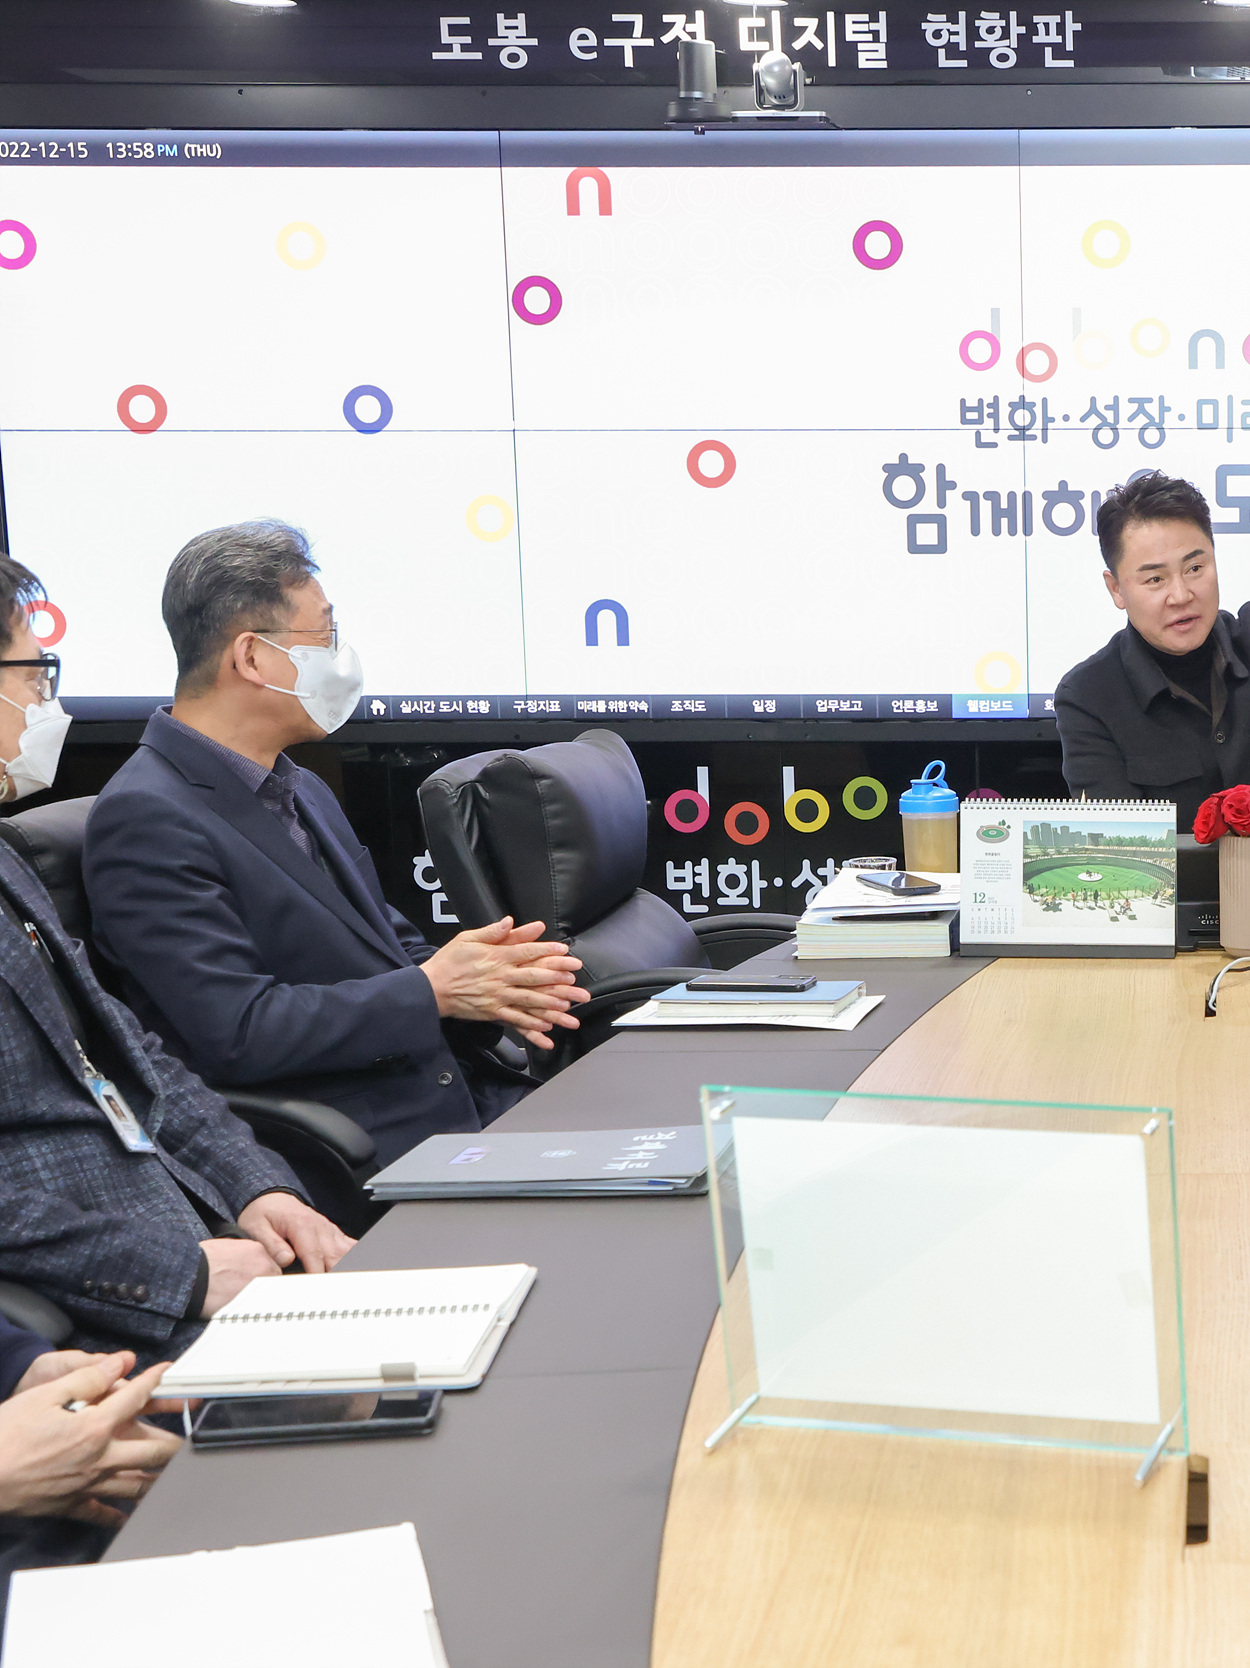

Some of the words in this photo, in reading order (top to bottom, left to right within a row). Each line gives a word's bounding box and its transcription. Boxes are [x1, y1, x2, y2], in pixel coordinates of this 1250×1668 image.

[432, 12, 539, 70] 도봉
[738, 10, 889, 69] 디지털
[920, 10, 1083, 69] 현황판
[0, 141, 89, 159] 022-12-15
[105, 142, 155, 159] 13:58
[157, 143, 178, 157] PM
[184, 143, 222, 159] (THU)
[399, 699, 436, 714] 실시간
[438, 699, 463, 714] 도시
[466, 699, 491, 714] 현황
[512, 699, 562, 714] 구정지표
[608, 699, 628, 714] 위한
[628, 699, 649, 714] 약속
[670, 699, 707, 714] 조직도
[752, 699, 777, 714] 일정
[815, 699, 863, 714] 업무보고
[891, 699, 939, 714] 언론홍보
[973, 891, 986, 904] 12
